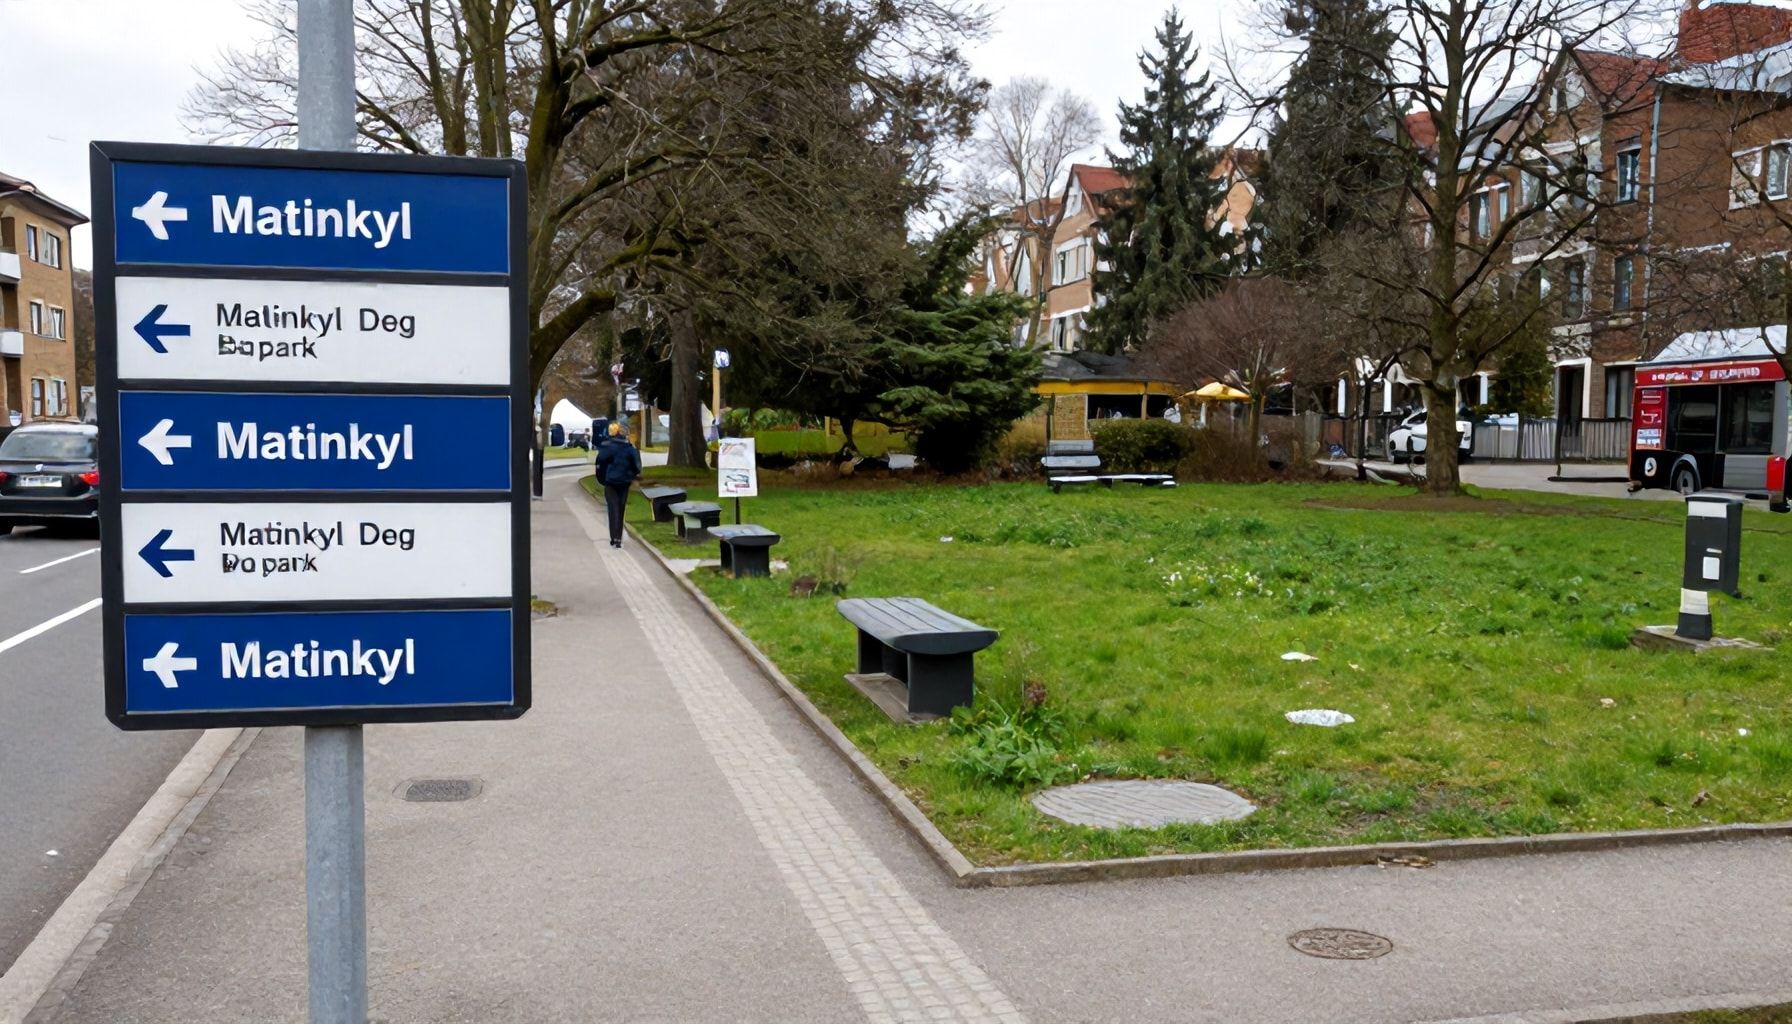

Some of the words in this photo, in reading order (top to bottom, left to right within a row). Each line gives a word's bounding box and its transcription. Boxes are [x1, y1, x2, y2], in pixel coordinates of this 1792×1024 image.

[211, 195, 412, 249] Matinkyl
[359, 308, 416, 338] Deg
[217, 422, 414, 470] Matinkyl
[220, 521, 344, 551] Matinkyl
[359, 522, 415, 551] Deg
[221, 638, 415, 686] Matinkyl
